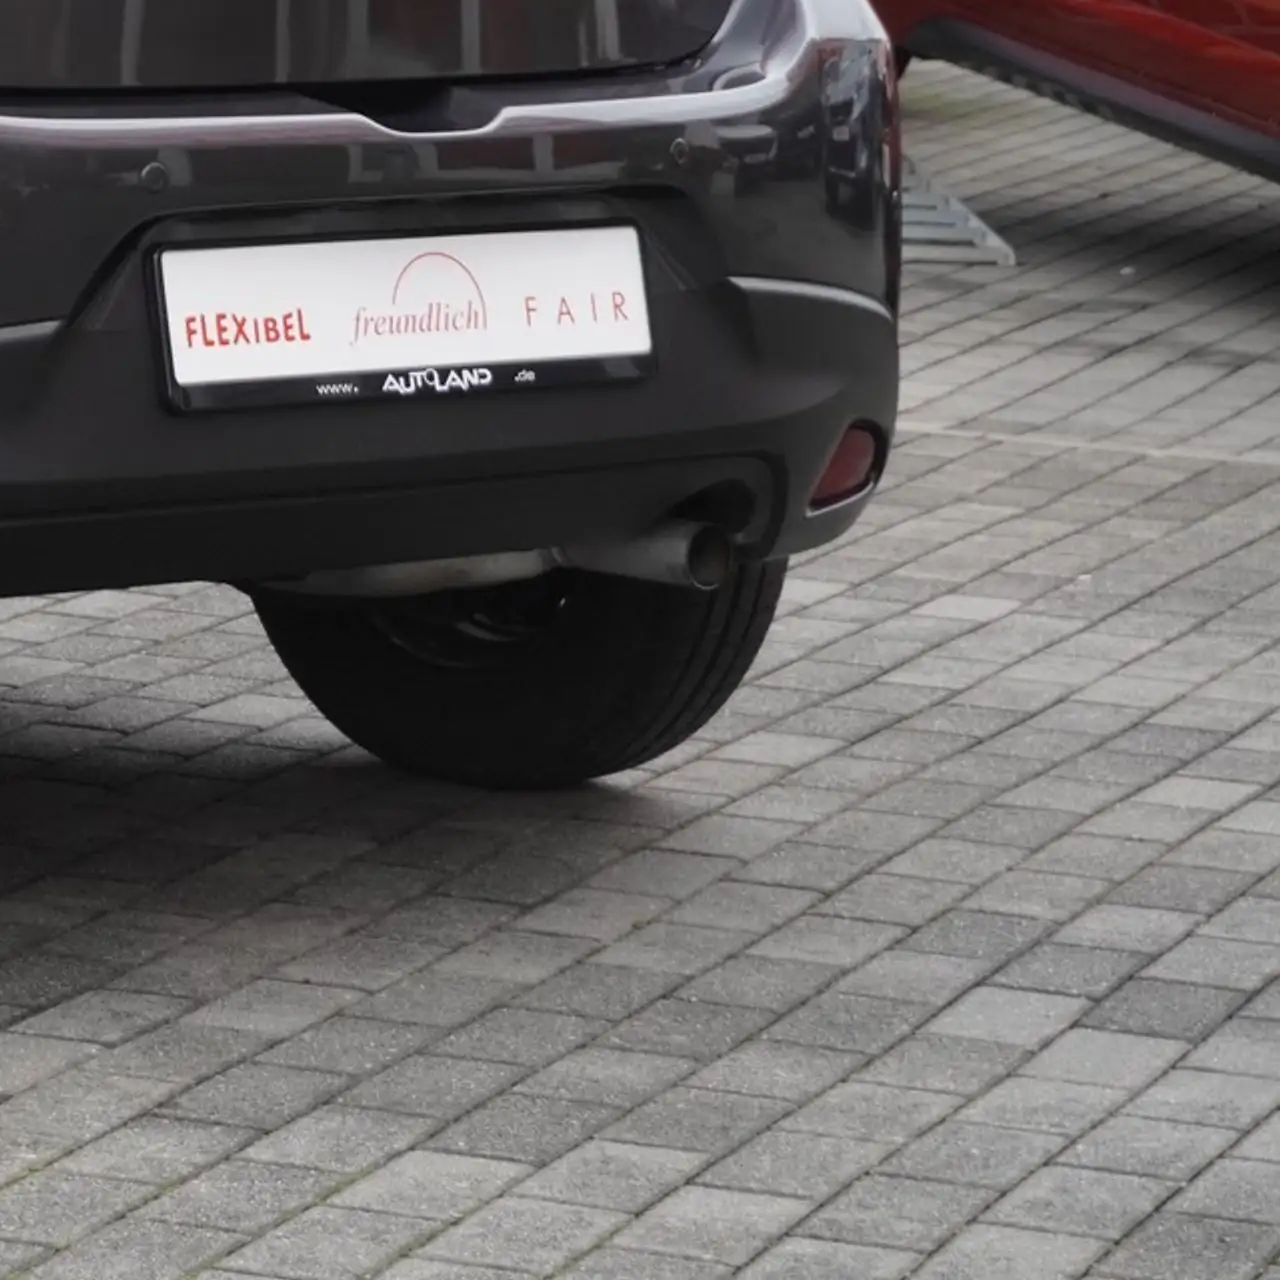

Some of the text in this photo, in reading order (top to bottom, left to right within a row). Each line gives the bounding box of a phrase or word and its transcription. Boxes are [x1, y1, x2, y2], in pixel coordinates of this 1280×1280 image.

[185, 307, 311, 348] FLEXIBEL
[349, 299, 485, 345] freundlich
[381, 367, 493, 395] AUTOLAND
